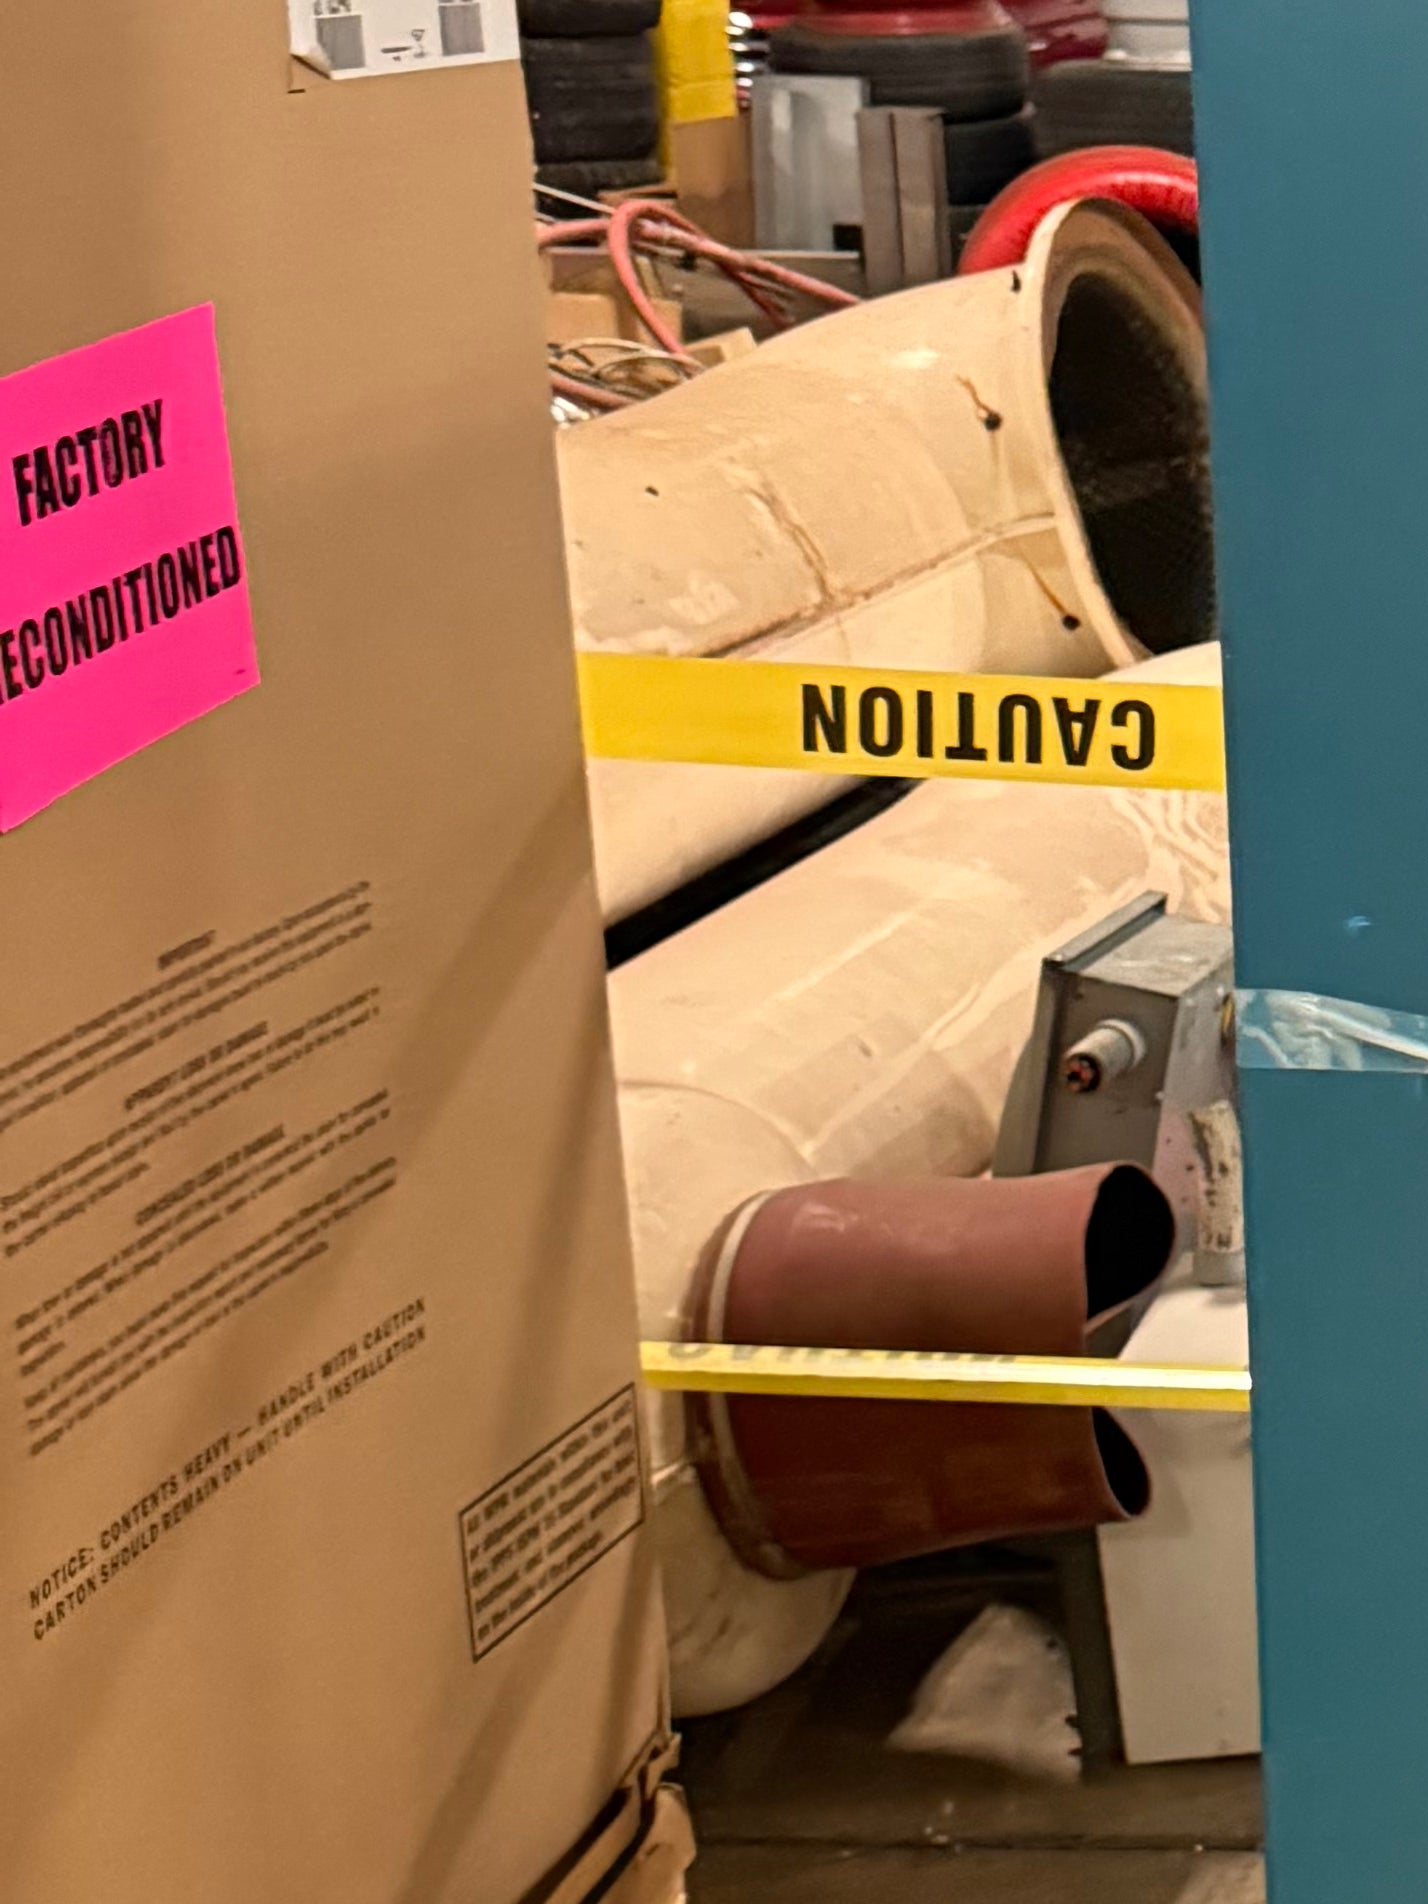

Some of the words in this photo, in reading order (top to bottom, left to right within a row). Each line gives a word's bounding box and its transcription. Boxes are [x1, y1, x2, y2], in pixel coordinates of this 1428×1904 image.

[12, 398, 166, 526] FACTORY
[0, 525, 240, 702] ECONDITIONED
[800, 682, 1157, 771] CAUTION
[29, 1547, 95, 1609] NOTICE:
[100, 1474, 179, 1551] CONTENTS
[183, 1432, 230, 1483] HEAVY
[33, 1577, 97, 1641] CARTON
[100, 1523, 159, 1584] SHOULD
[161, 1475, 220, 1531] REMAIN
